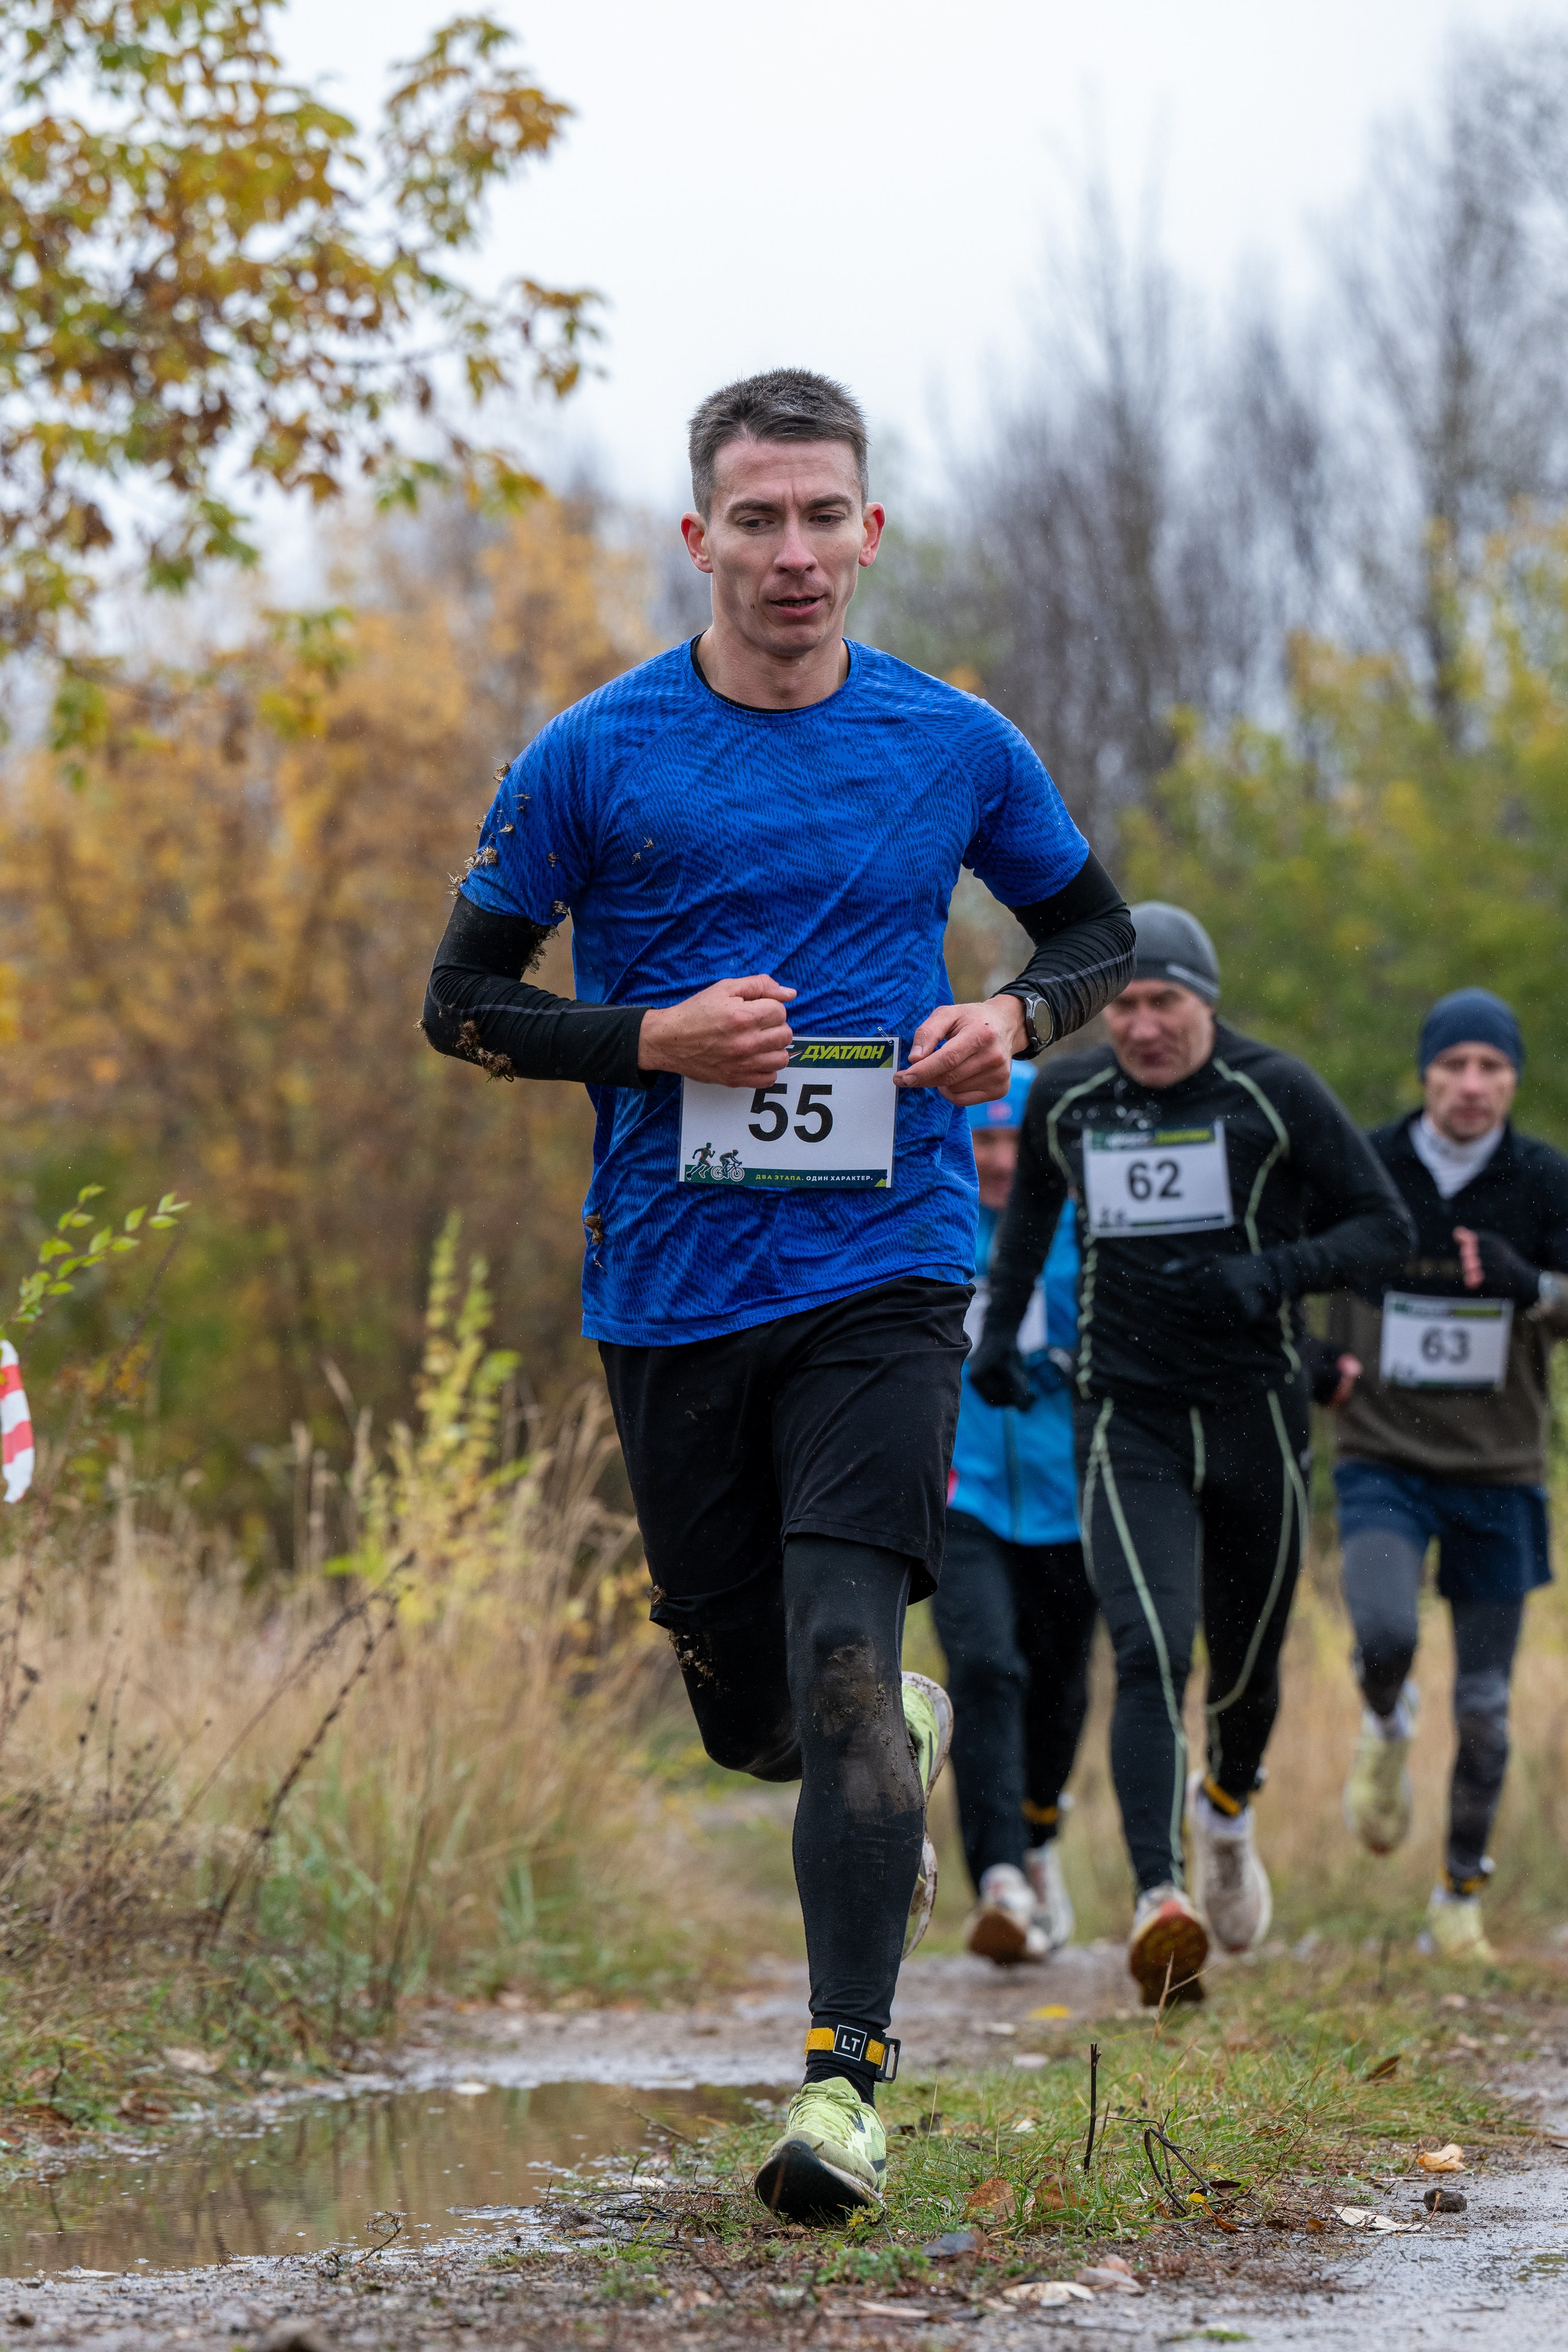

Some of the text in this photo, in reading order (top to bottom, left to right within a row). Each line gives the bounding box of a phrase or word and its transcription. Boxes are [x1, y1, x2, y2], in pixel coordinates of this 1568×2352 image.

[799, 1045, 885, 1061] ДУАТЛОН
[748, 1083, 834, 1143] 55
[1127, 1159, 1182, 1200] 62
[1421, 1327, 1470, 1365] 63
[841, 2035, 861, 2052] LT
